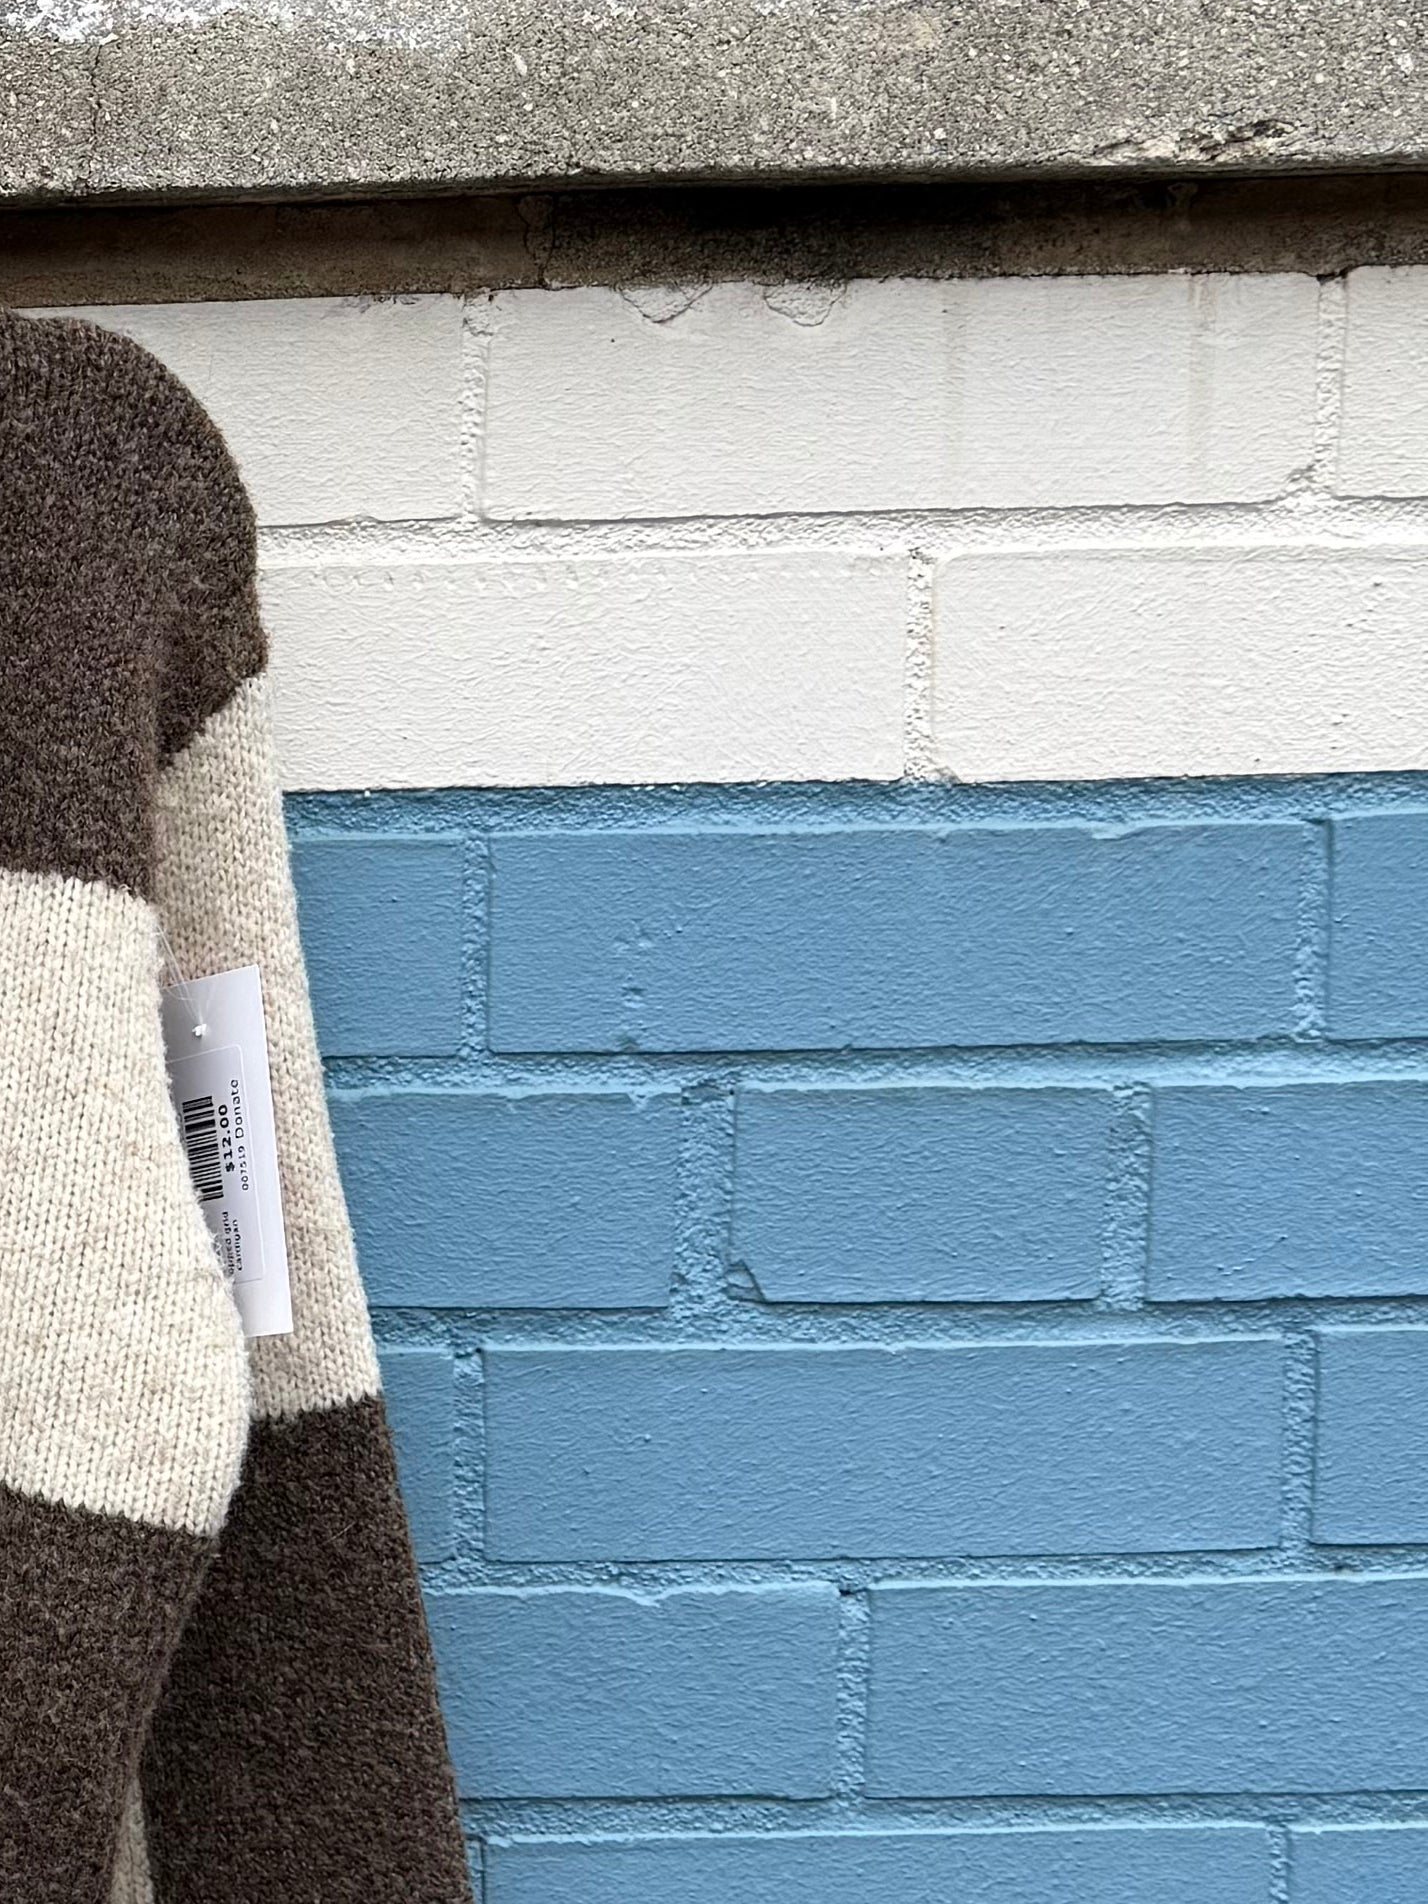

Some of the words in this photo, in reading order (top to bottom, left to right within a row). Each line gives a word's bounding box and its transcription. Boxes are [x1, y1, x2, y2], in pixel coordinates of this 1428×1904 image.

[217, 1104, 235, 1172] $12.00
[230, 1078, 244, 1139] Donate
[231, 1218, 243, 1271] cardigan
